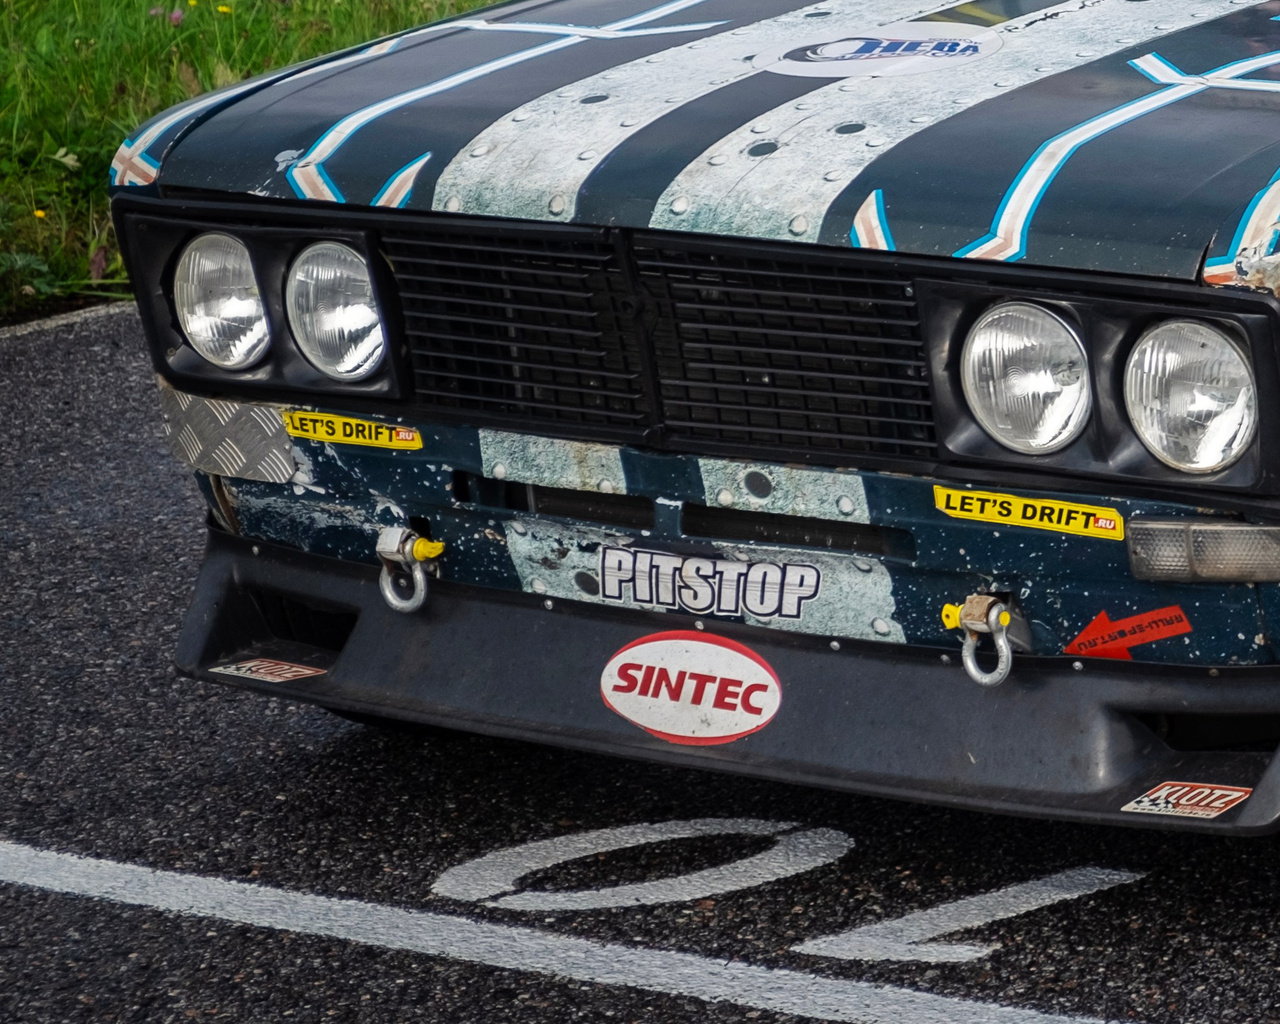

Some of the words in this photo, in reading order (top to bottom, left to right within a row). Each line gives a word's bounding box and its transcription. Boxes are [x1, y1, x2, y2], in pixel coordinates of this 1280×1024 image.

[289, 415, 336, 436] LET'S
[944, 493, 1012, 518] LET'S
[600, 546, 822, 619] PITSTOP
[611, 662, 769, 716] SINTEC
[1148, 785, 1246, 808] KLOTZ
